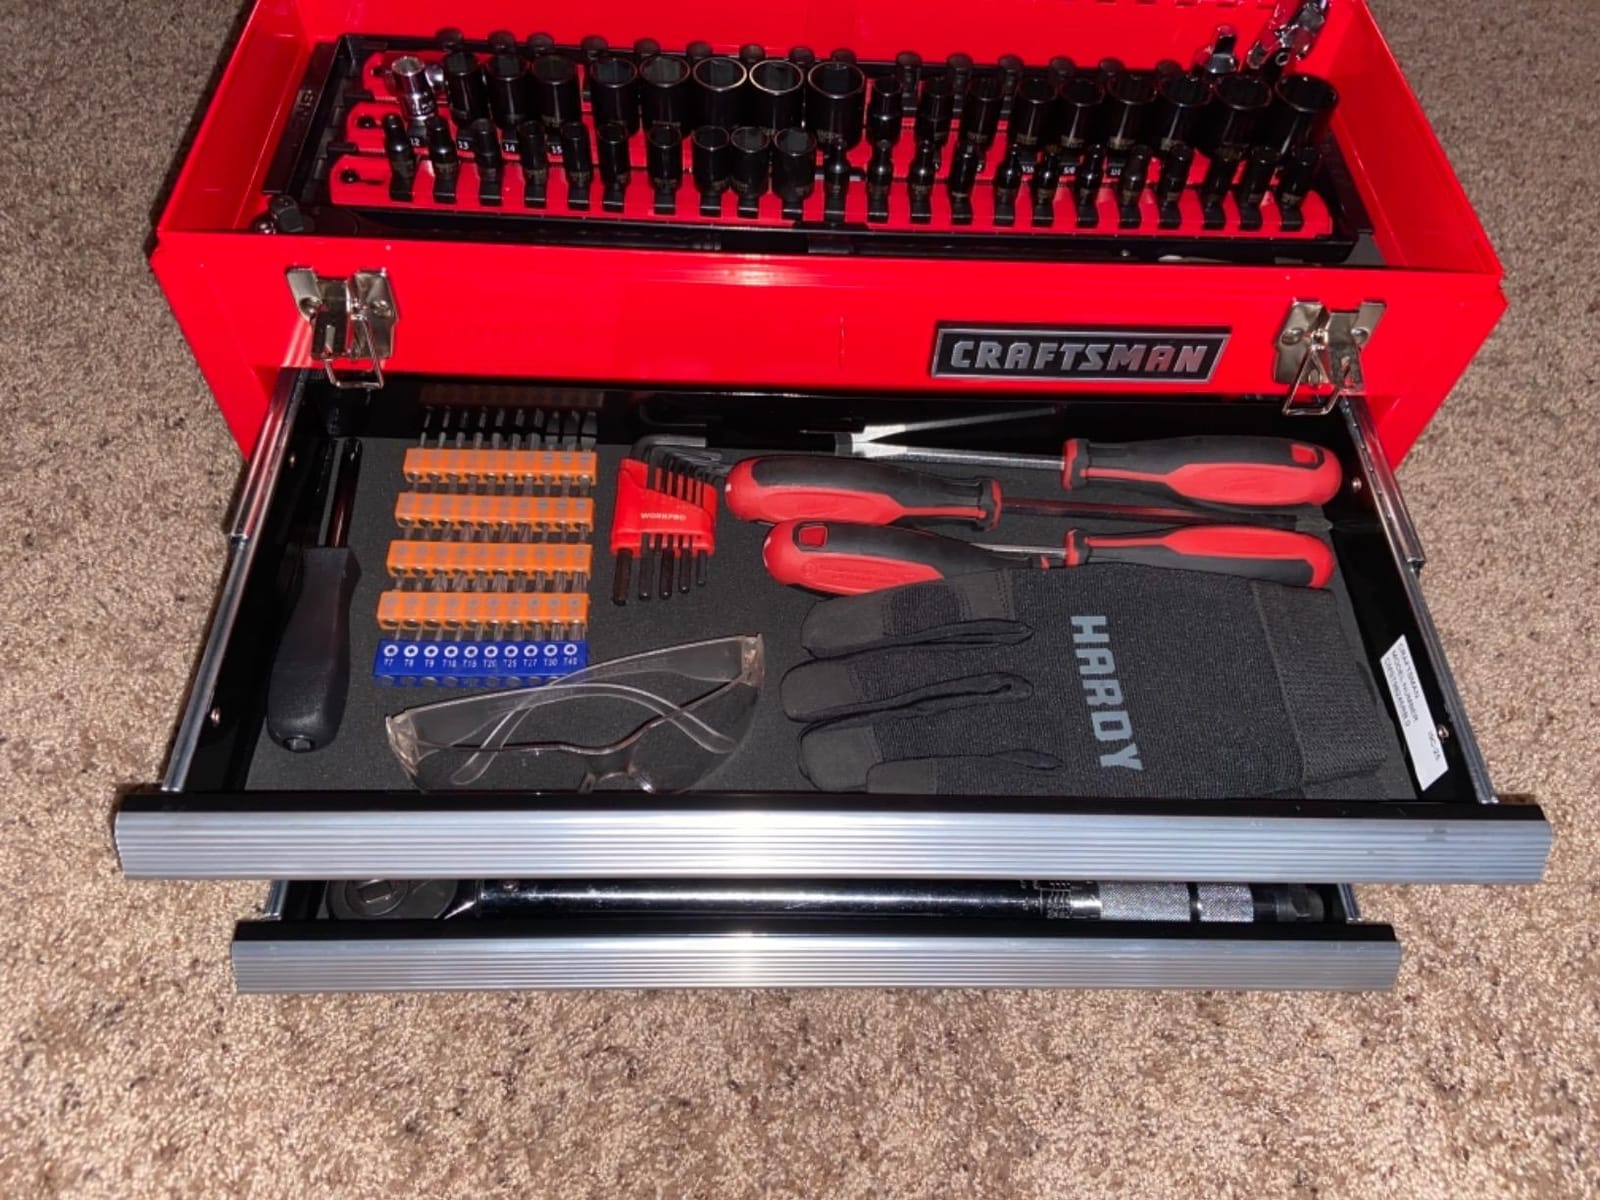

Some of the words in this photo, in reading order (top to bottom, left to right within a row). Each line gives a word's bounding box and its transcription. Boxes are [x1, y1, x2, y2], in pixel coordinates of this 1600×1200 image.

[950, 340, 1209, 373] CRAFTSMAN
[640, 512, 687, 522] WORKPRO
[384, 658, 394, 666] T7
[424, 659, 434, 668] T9
[522, 658, 538, 667] T27
[544, 658, 558, 666] T30
[1070, 615, 1144, 771] HARDY
